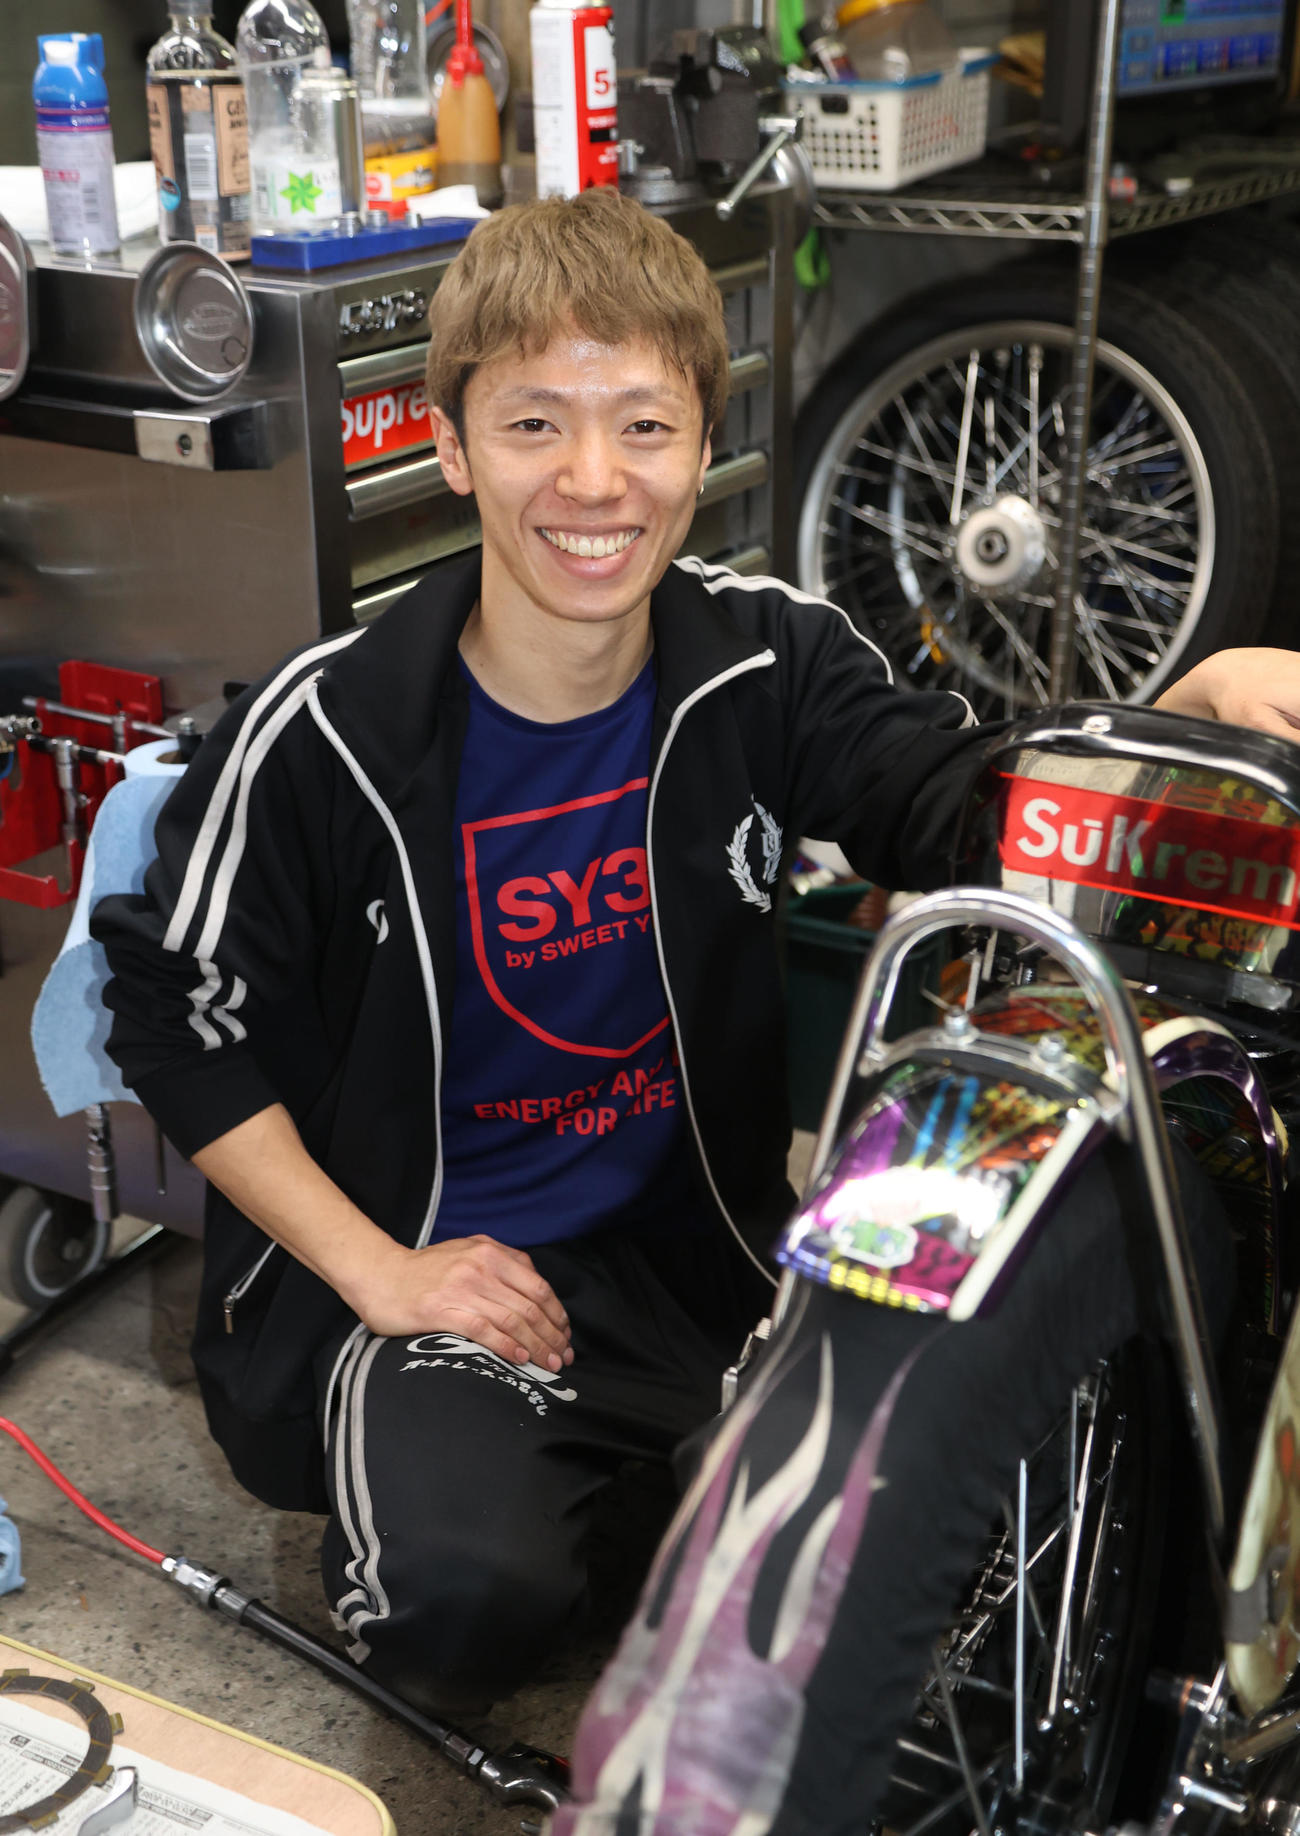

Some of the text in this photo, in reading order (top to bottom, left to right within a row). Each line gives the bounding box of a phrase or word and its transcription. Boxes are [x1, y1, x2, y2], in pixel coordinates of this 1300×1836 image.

[341, 386, 431, 448] Supre
[1016, 797, 1300, 907] SūKrem
[505, 912, 655, 969] by SWEET Y
[473, 1050, 680, 1123] ENERGY AN
[556, 1107, 618, 1135] FOR
